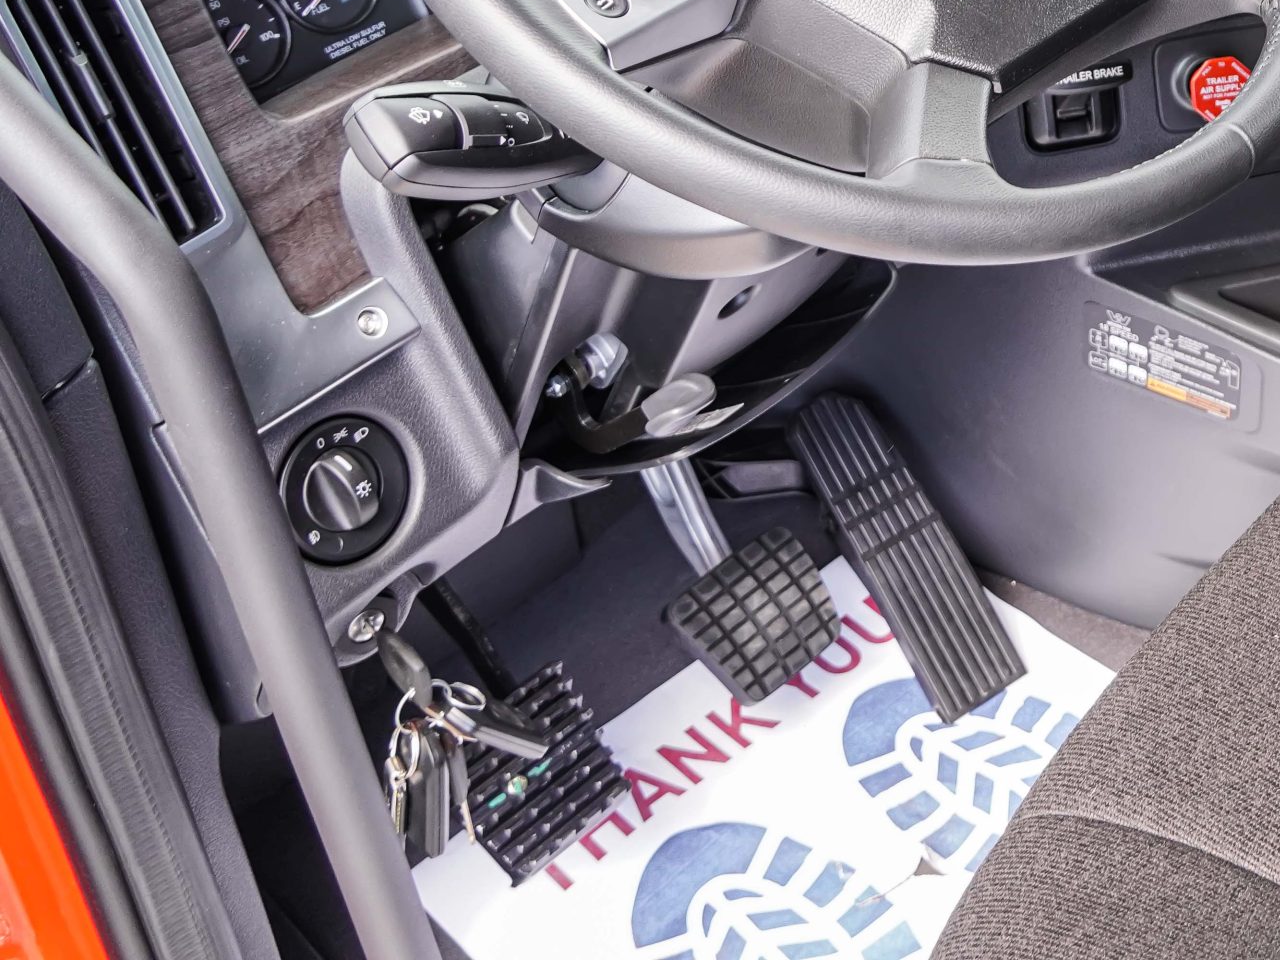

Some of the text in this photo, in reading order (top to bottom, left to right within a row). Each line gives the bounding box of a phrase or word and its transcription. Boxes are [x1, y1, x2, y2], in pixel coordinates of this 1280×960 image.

[312, 3, 331, 16] FUEL
[324, 40, 346, 54] ULTRA
[345, 32, 361, 44] LOW
[352, 37, 369, 49] FUEL
[1093, 65, 1124, 80] BRAKE
[1206, 75, 1239, 85] TRAILER
[1200, 86, 1214, 95] AIR
